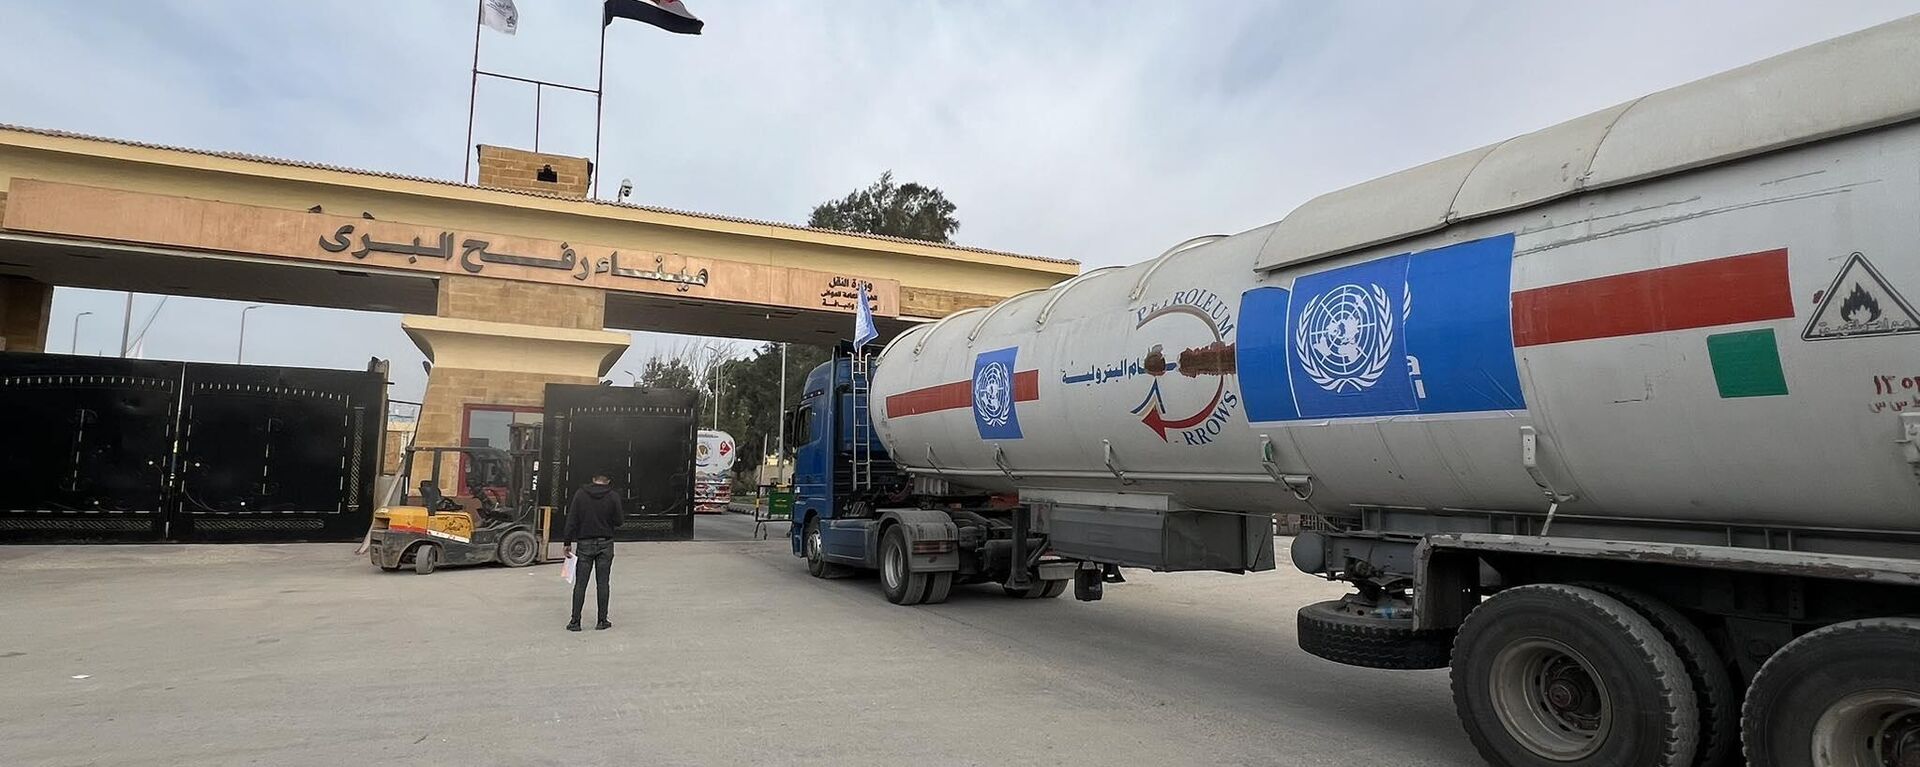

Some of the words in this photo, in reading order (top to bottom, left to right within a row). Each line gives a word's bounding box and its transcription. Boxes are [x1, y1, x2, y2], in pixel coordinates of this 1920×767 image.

[460, 238, 590, 281] رفح
[594, 250, 710, 292] ميناء
[828, 276, 850, 288] النقل
[851, 278, 873, 293] وزارة
